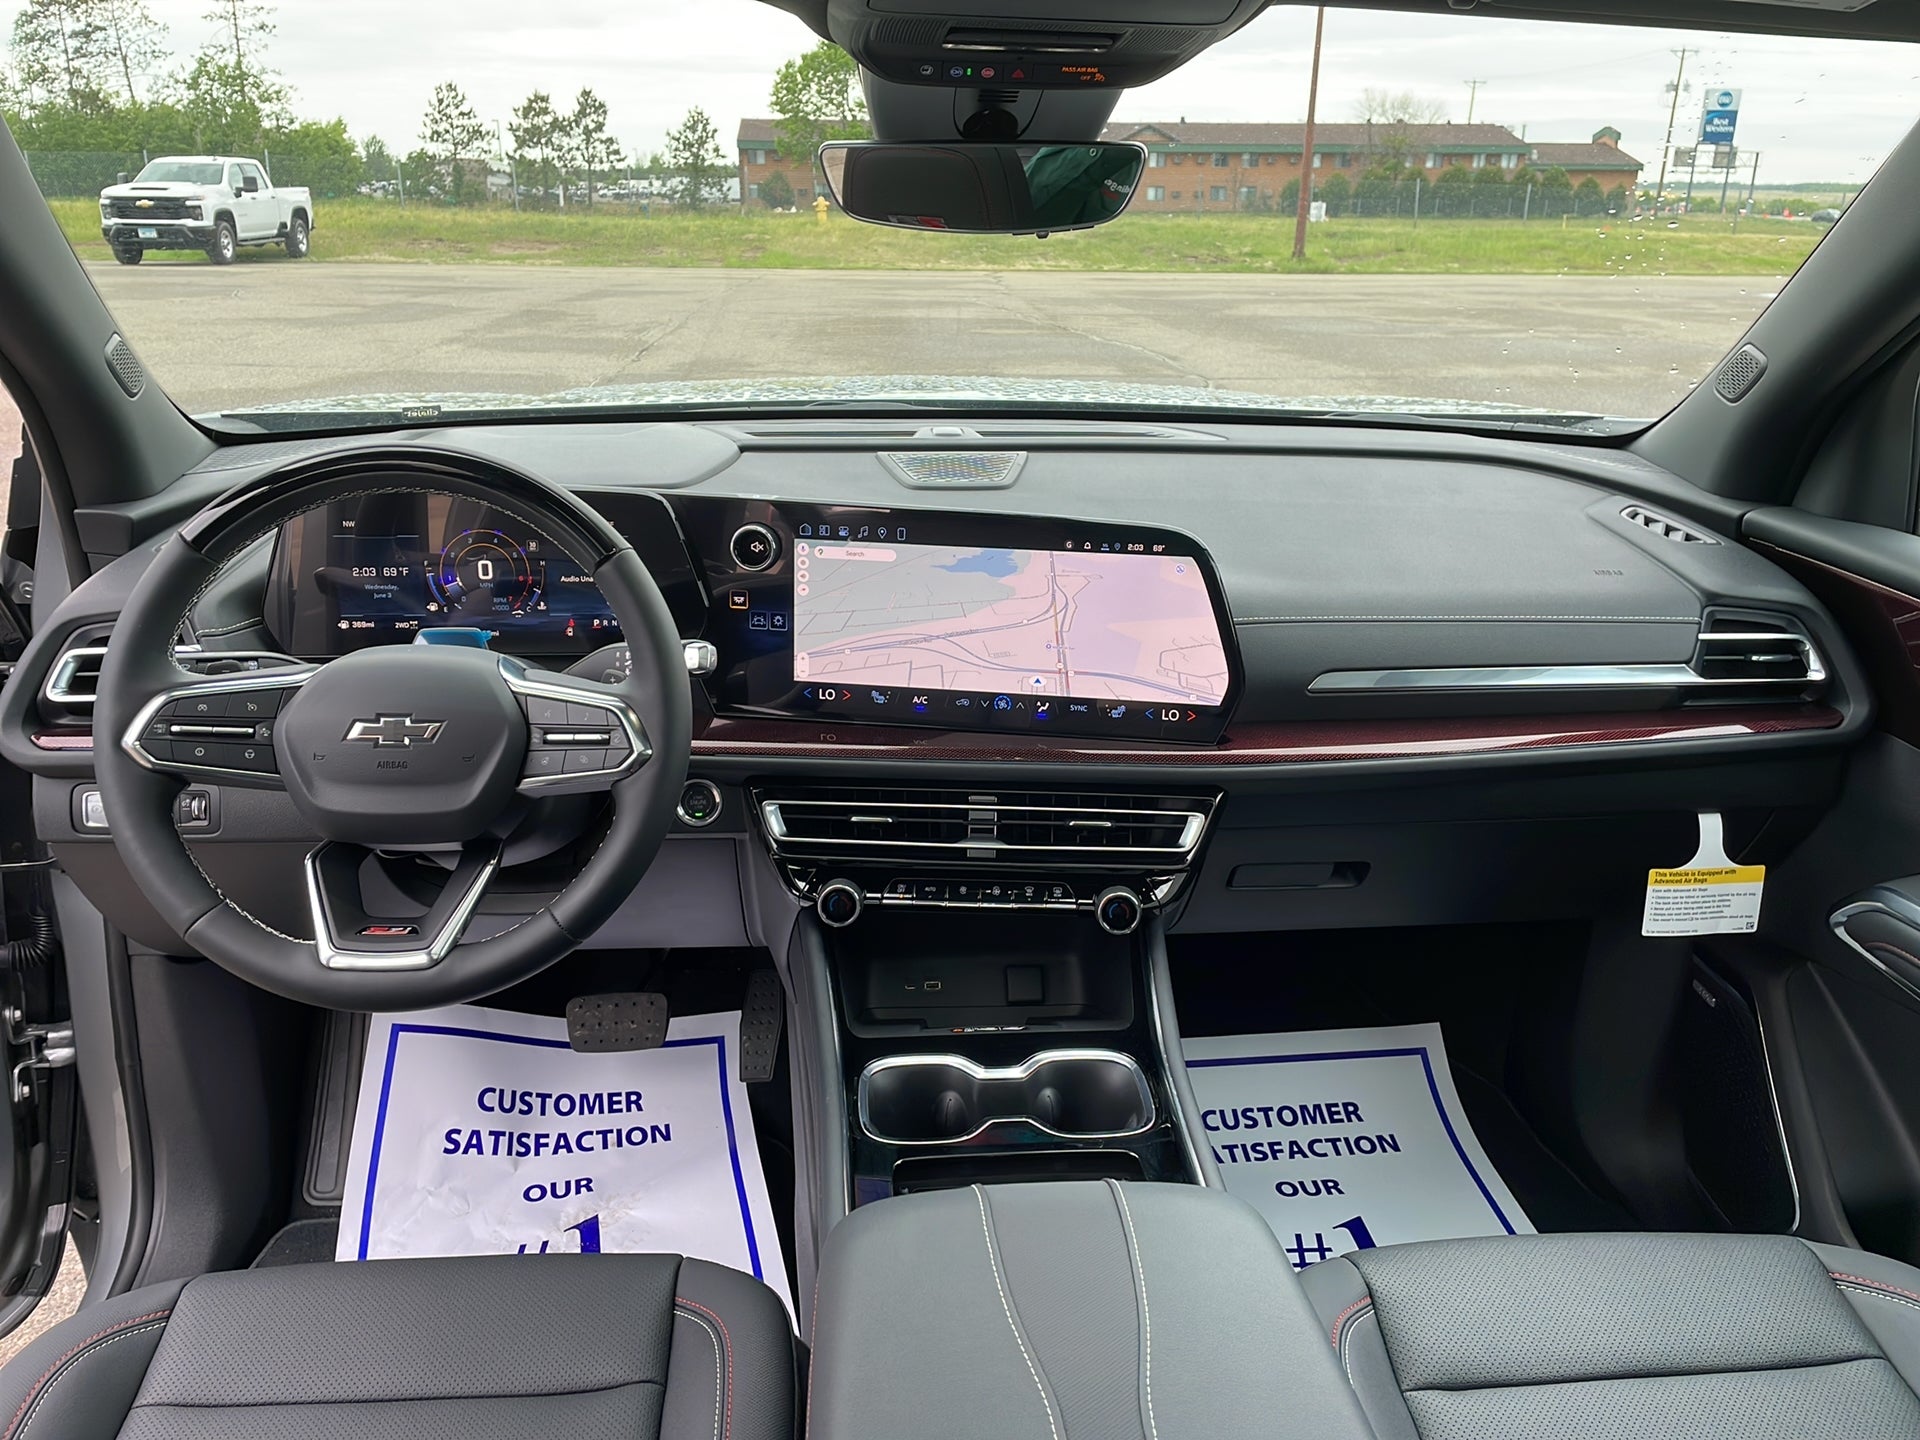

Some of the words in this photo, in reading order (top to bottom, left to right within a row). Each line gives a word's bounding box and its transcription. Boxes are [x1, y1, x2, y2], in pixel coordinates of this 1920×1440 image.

[1713, 117, 1729, 126] Best
[1705, 124, 1734, 133] Western
[342, 520, 356, 528] NW
[1127, 543, 1144, 551] 2:03
[352, 567, 376, 577] 2:03
[383, 567, 397, 577] 69
[477, 560, 493, 580] 0
[364, 583, 400, 591] Wednesday,
[818, 688, 836, 701] LO
[912, 695, 928, 704] A/C
[1069, 704, 1088, 713] SYNC
[1161, 709, 1180, 722] LO
[376, 760, 408, 769] AIRBAG
[1668, 870, 1690, 878] Vehicle
[1697, 870, 1724, 878] Equipped
[1653, 877, 1683, 885] Advanced
[1693, 877, 1708, 885] Bags
[477, 1086, 644, 1117] CUSTOMER
[1201, 1101, 1364, 1132] CUSTOMER
[443, 1123, 672, 1158] SATISFACTION
[1211, 1133, 1401, 1165] TISFACTION
[522, 1176, 594, 1203] OUR
[1275, 1178, 1345, 1198] OUR
